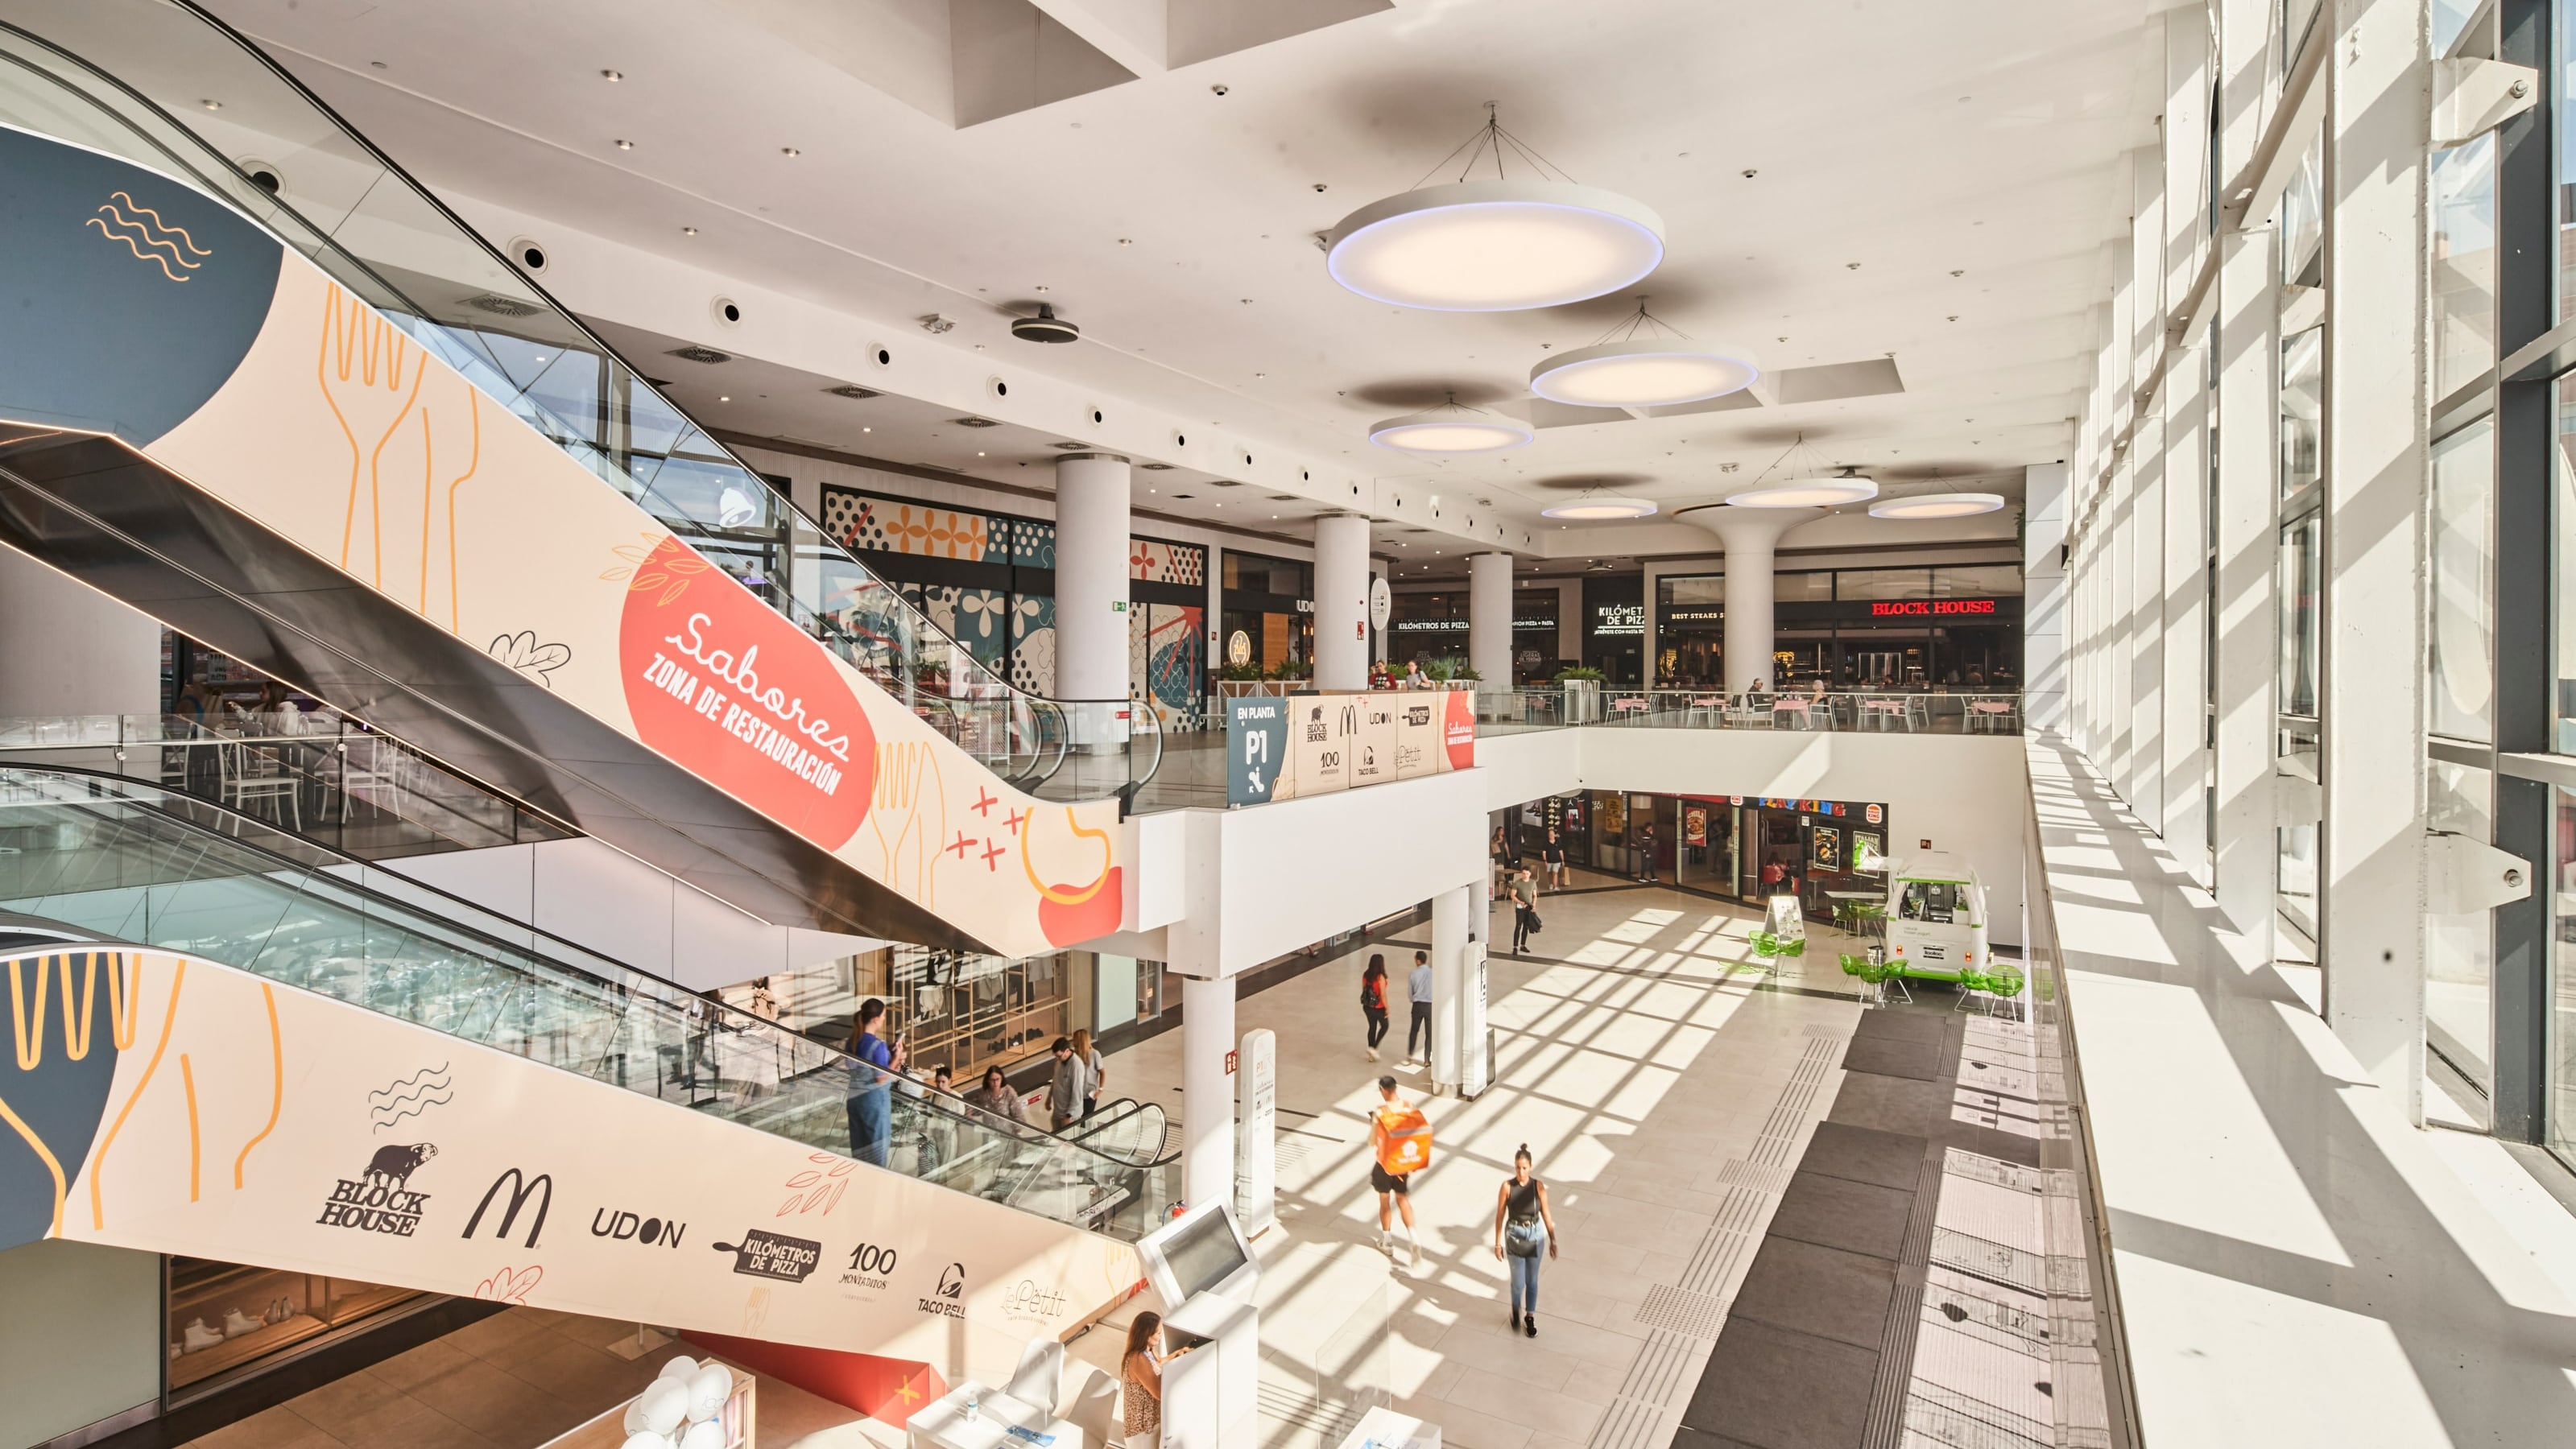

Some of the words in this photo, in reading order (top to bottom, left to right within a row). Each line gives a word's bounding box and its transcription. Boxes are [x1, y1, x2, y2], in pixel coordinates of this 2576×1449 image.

[1296, 599, 1314, 613] UDO
[1598, 604, 1644, 617] KILÓMET
[1872, 602, 1929, 616] BLOCK
[1933, 601, 1995, 614] HOUSE
[1398, 621, 1439, 630] KILÓMETROS
[1440, 621, 1450, 630] DE
[1451, 621, 1470, 629] PIZZA
[1606, 616, 1621, 625] DE
[664, 612, 850, 762] Sabores
[1238, 708, 1248, 720] EN
[1249, 706, 1276, 719] PLANTA
[1369, 712, 1391, 724] UDON
[642, 652, 698, 704] ZONA
[694, 685, 727, 721] DE
[722, 703, 842, 796] RESTAURACIÓN
[1307, 723, 1327, 733] BLOCK
[1307, 733, 1327, 742] HOUSE
[1246, 730, 1267, 765] P1
[1321, 751, 1339, 767] 100
[1799, 799, 1846, 817] KING
[328, 1179, 431, 1216] BLOCK
[316, 1202, 420, 1237] HOUSE
[591, 1208, 686, 1249] UDON
[743, 1238, 817, 1265] KILÓMETROS
[848, 1243, 896, 1275] 100
[749, 1255, 768, 1270] DE
[770, 1258, 800, 1276] PIZZA
[838, 1273, 888, 1290] MONTADITOS
[918, 1298, 943, 1314] TACO
[944, 1303, 965, 1319] BELL
